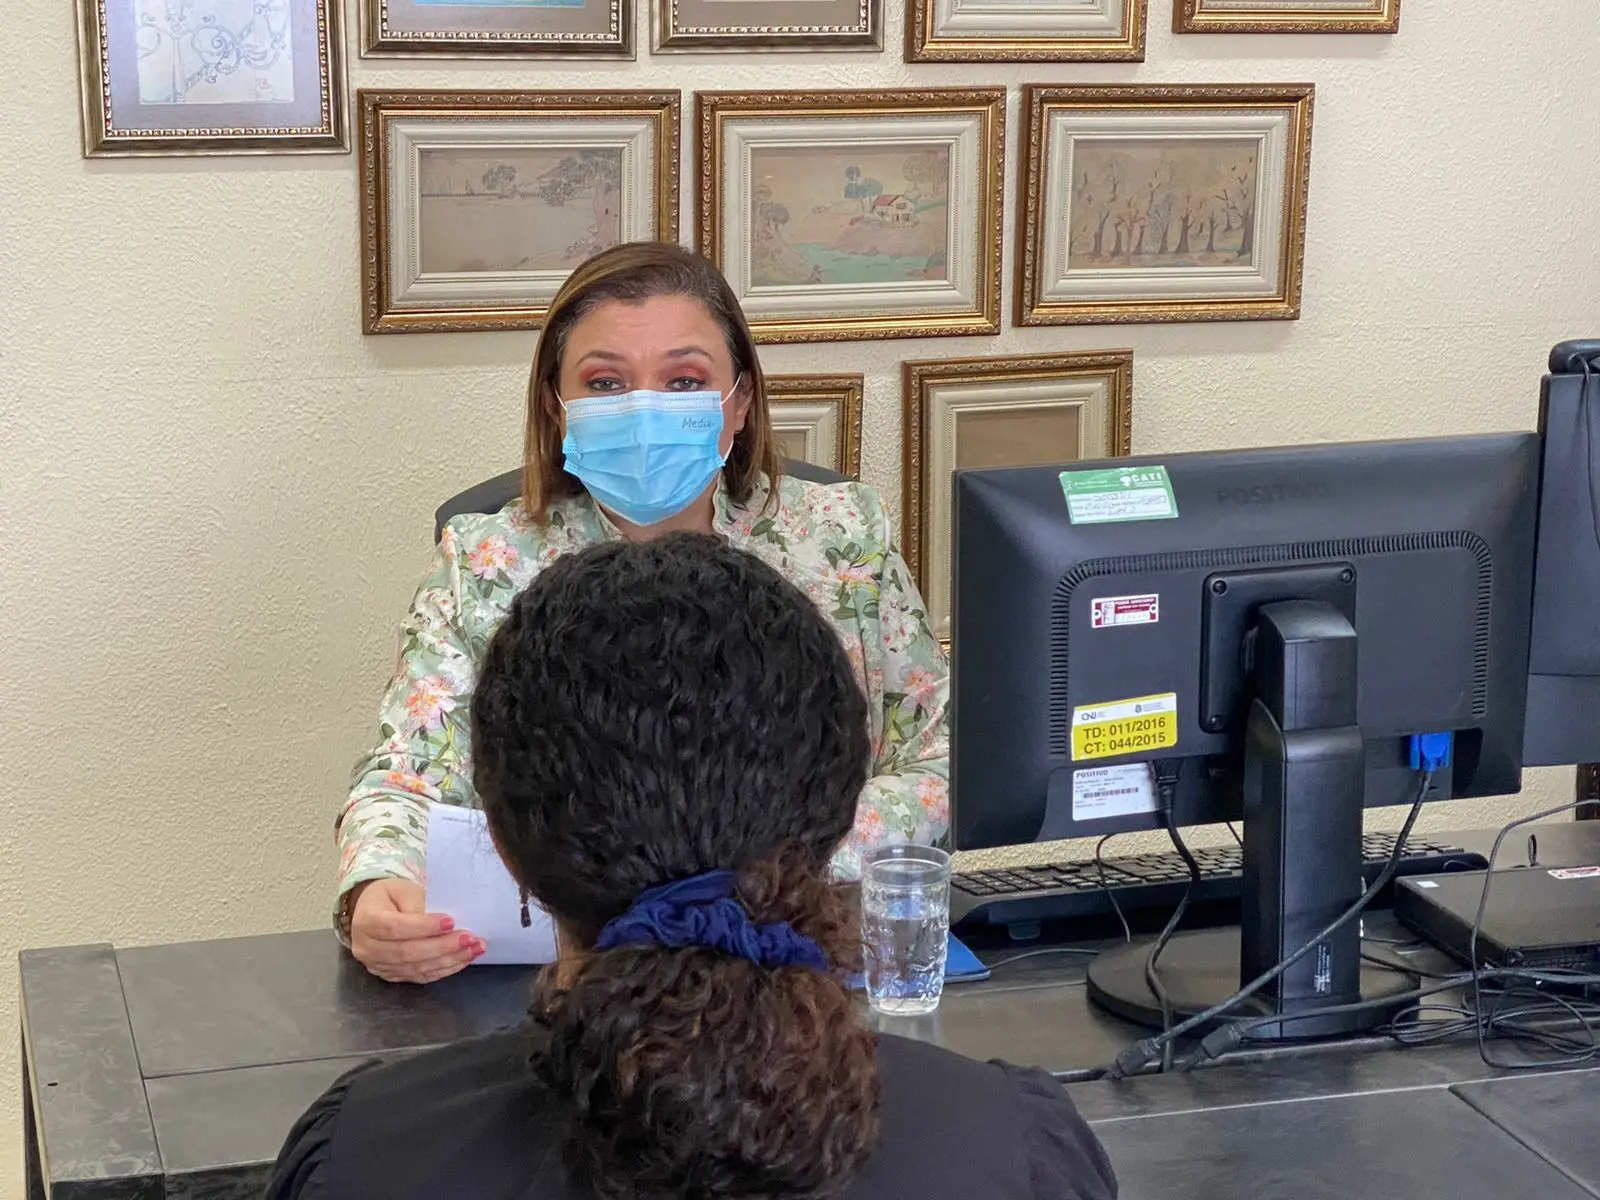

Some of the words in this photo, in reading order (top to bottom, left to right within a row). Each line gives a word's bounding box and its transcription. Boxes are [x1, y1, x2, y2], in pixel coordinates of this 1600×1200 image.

[1132, 472, 1162, 482] CATI
[1083, 727, 1106, 740] TD:
[1109, 717, 1166, 736] 011/2016
[1083, 742, 1106, 755] CT:
[1109, 732, 1166, 751] 044/2015
